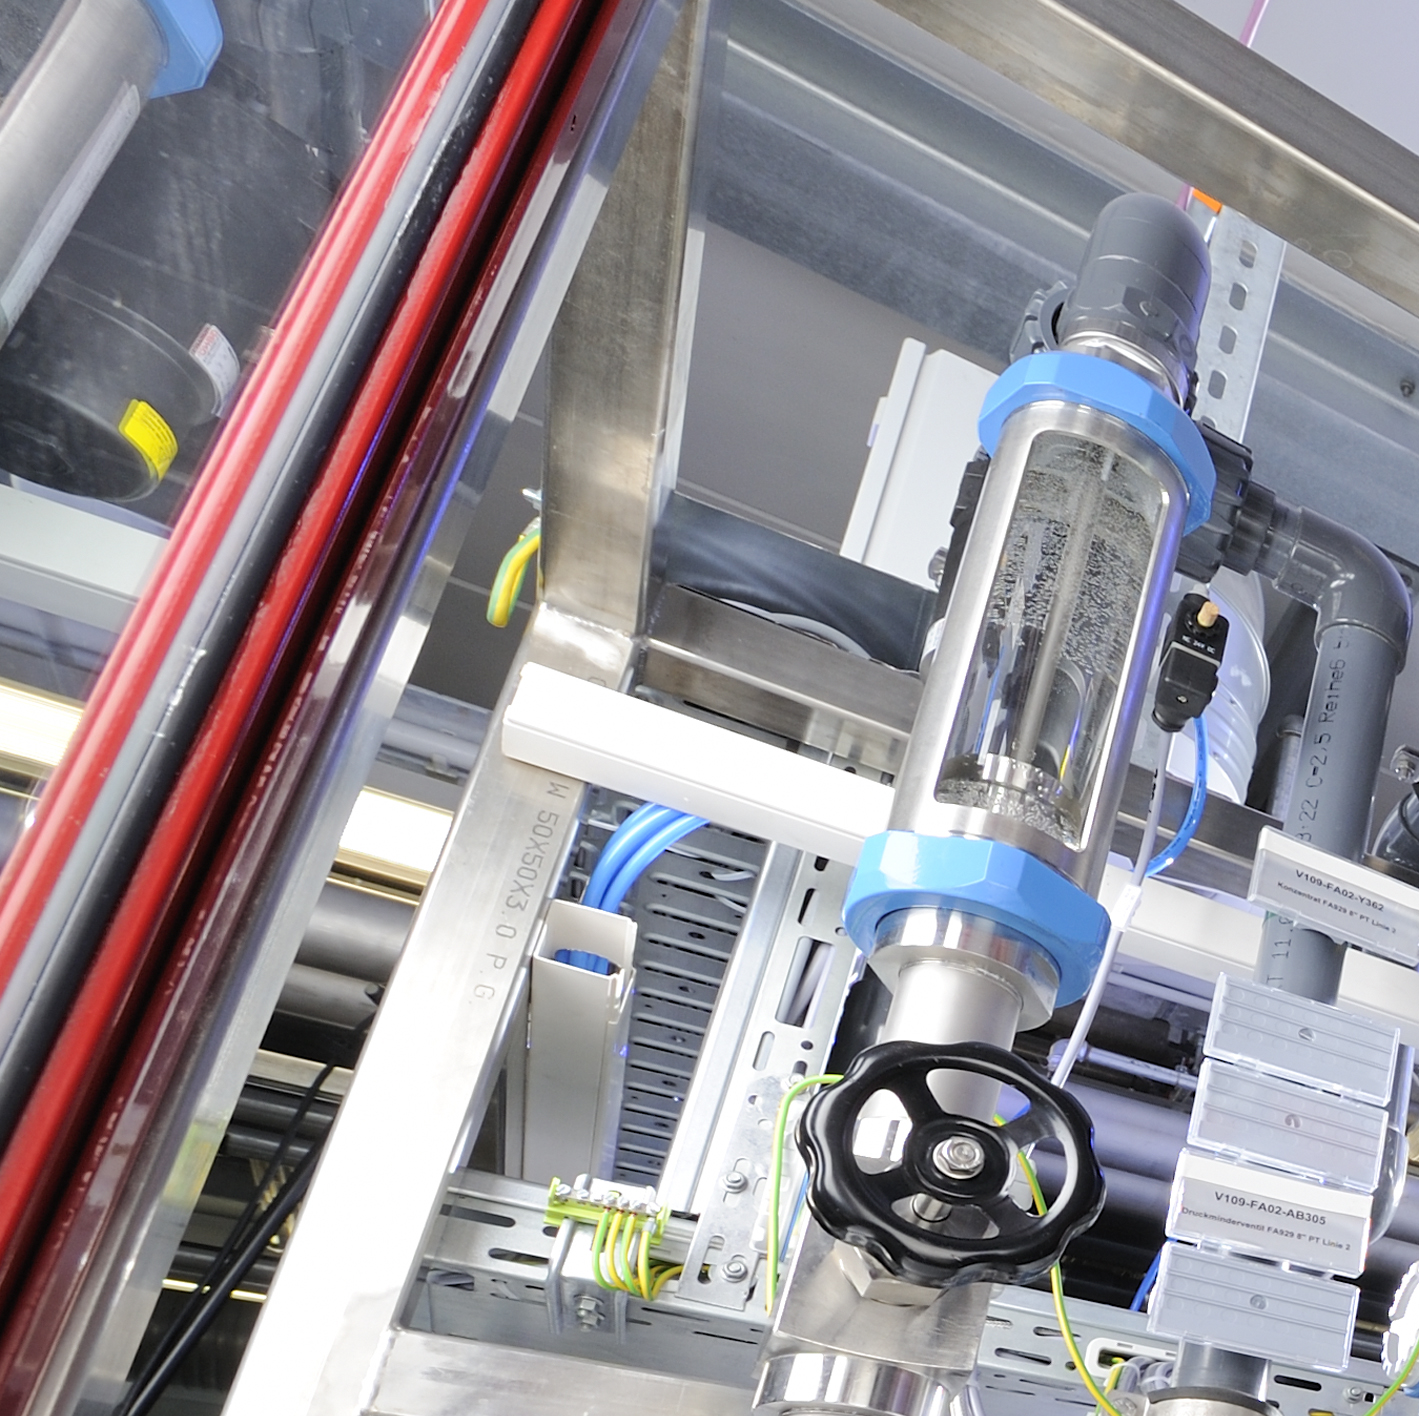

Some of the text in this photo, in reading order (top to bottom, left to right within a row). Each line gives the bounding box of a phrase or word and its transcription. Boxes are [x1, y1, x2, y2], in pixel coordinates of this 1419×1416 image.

[494, 809, 560, 940] 50X50X3.0
[1295, 868, 1385, 912] V109-FA02-Y362
[1182, 1206, 1265, 1232] Druckminderventil
[1322, 1238, 1343, 1250] Linie
[1214, 1190, 1326, 1226] V109-FA02-AB305
